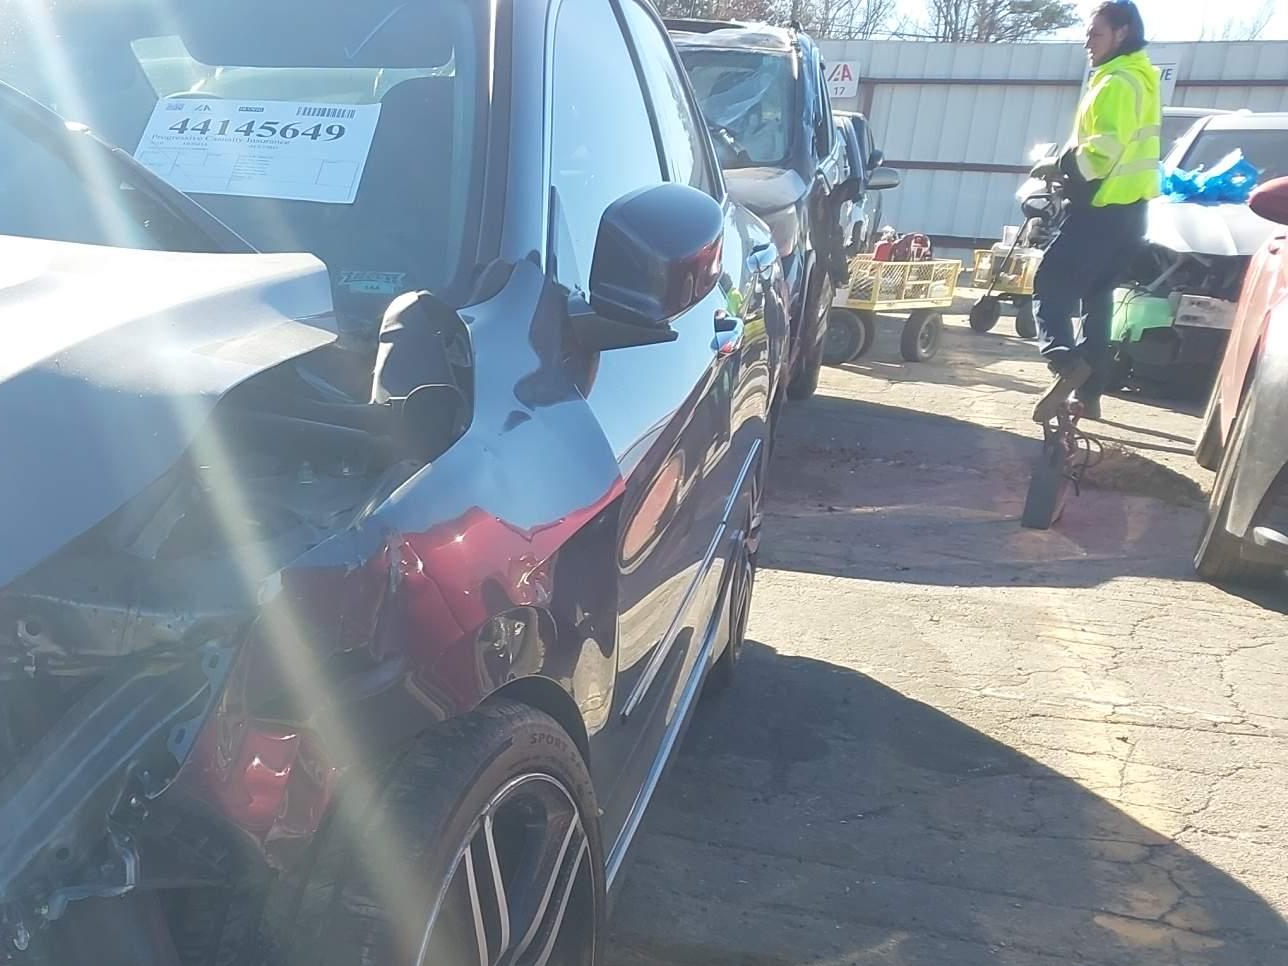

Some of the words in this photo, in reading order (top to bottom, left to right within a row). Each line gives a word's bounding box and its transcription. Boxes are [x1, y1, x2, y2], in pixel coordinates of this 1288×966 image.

[833, 86, 847, 97] 17
[169, 118, 345, 141] 44145649
[150, 134, 205, 143] Progressive
[205, 135, 244, 144] Casualty
[246, 137, 291, 145] Insurance
